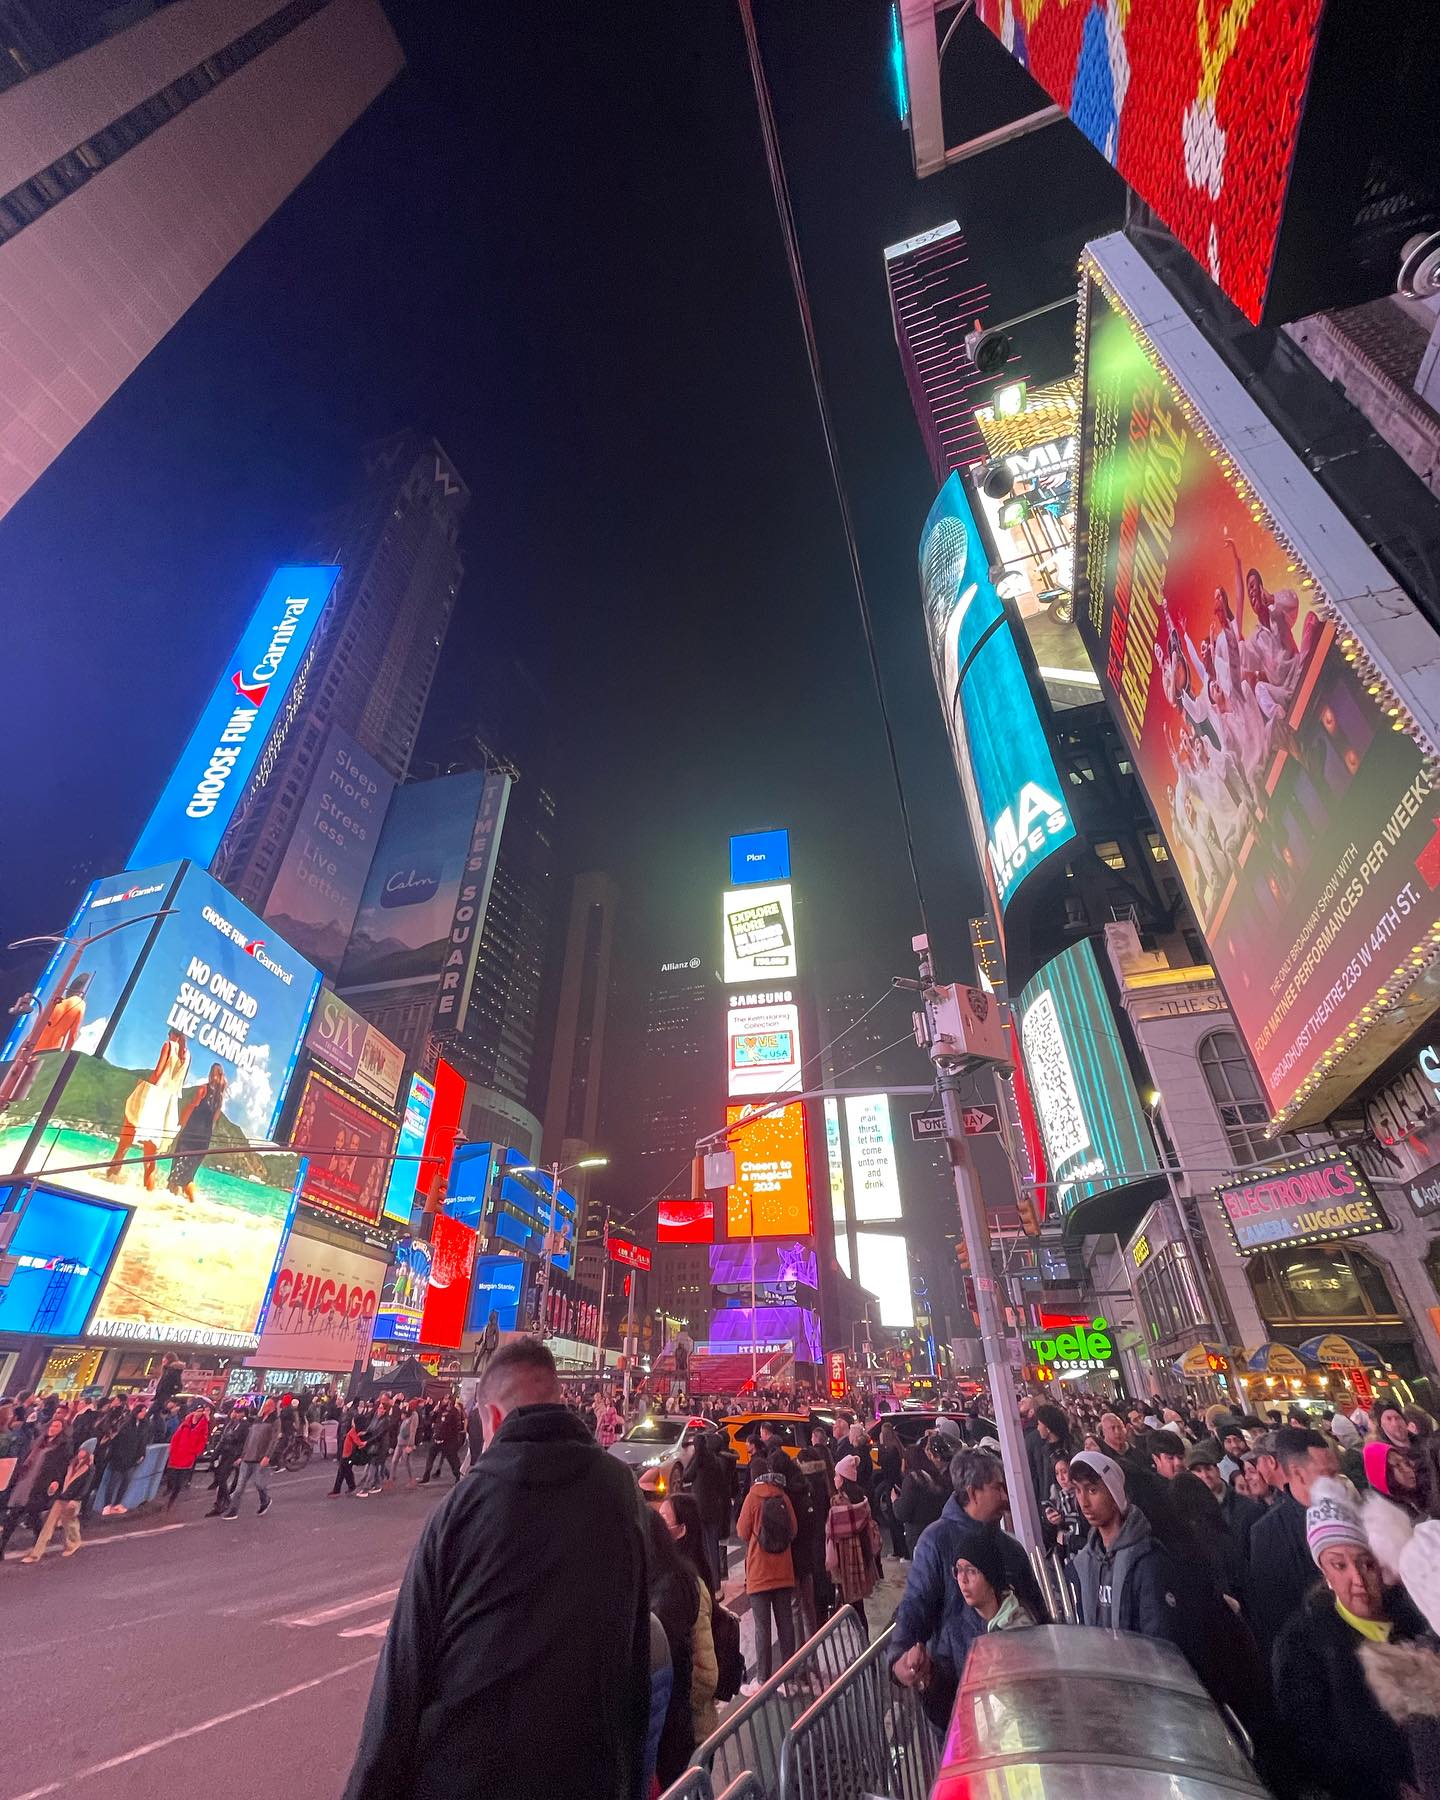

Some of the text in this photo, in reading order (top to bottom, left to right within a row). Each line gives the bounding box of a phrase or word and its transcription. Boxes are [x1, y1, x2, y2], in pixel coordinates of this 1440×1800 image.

[905, 230, 941, 249] TSX
[1140, 388, 1187, 545] NOISE
[1121, 526, 1166, 731] BEAUTIFUL
[186, 596, 309, 818] CHOOSE FUN Carnival
[336, 750, 377, 794] Sleep
[330, 770, 373, 813] more.
[314, 810, 347, 849] less.
[320, 793, 366, 840] Stress
[304, 839, 337, 875] Live
[747, 853, 765, 861] Plan
[997, 810, 1067, 900] SHOES
[386, 869, 437, 894] Calm
[438, 785, 499, 1014] TIMES SQUARE
[729, 902, 779, 925] EXPLORE
[732, 917, 765, 936] MORE
[1253, 764, 1435, 1057] FOUR MATINEE PERFORMANCES PER WEEK!
[1269, 841, 1359, 995] THE ONLY BROADWAY SHOW WITH
[202, 905, 293, 986] CHOOSE FUN Carnival
[661, 961, 688, 971] Allianz
[186, 956, 258, 1019] NO ONE DID
[729, 991, 792, 1007] SAMSUNG
[1270, 1026, 1311, 1086] BROADHURST
[1308, 980, 1345, 1034] THEATRE
[1340, 957, 1362, 991] 235
[1357, 941, 1374, 968] W
[1367, 906, 1400, 955] 44TH
[167, 1003, 196, 1039] LIKE
[177, 982, 250, 1043] SHOW TIME
[1166, 999, 1201, 1014] THE
[770, 1049, 788, 1058] USA
[857, 1157, 889, 1167] unto me
[861, 1146, 882, 1156] come
[753, 1181, 782, 1193] 2024
[864, 1180, 885, 1190] drink
[867, 1168, 882, 1178] and
[1222, 1164, 1355, 1219] ELECTRONICS
[1238, 1202, 1370, 1243] CAMERA LUGGAGE
[272, 1268, 376, 1321] CHICAGO
[90, 1320, 163, 1341] AMERICAN
[165, 1327, 201, 1344] EAGLE
[1031, 1317, 1112, 1365] pelé
[831, 1353, 841, 1380] tkts
[1053, 1359, 1105, 1369] SOCCER
